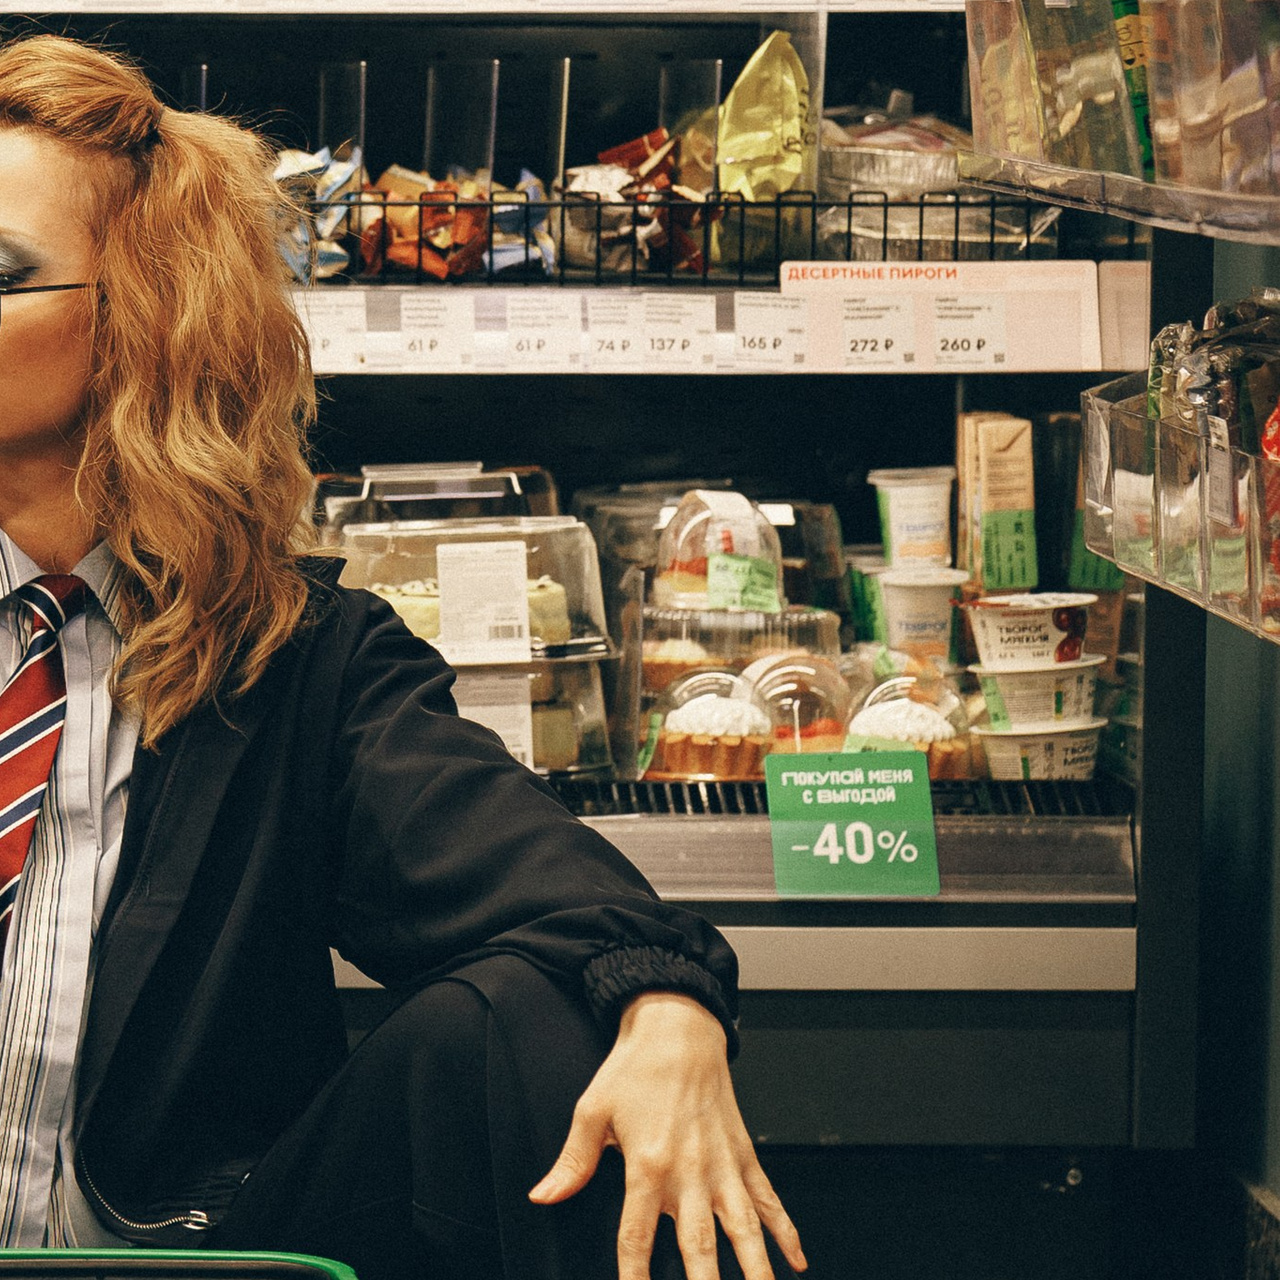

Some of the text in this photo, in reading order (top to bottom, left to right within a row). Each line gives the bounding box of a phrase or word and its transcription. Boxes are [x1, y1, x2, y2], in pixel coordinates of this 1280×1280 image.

[787, 266, 957, 281] ДЕСЕРТНЫЕ ПИРОГИ
[408, 339, 424, 351] 61
[515, 339, 532, 351] 61
[597, 339, 615, 351] 74
[650, 338, 675, 350] 137
[741, 337, 767, 349] 165
[849, 339, 878, 351] 272
[940, 338, 971, 351] 260
[868, 768, 914, 784] МЕНЯ
[802, 785, 897, 805] С ВЫГОДОЙ
[791, 821, 918, 864] -40%
